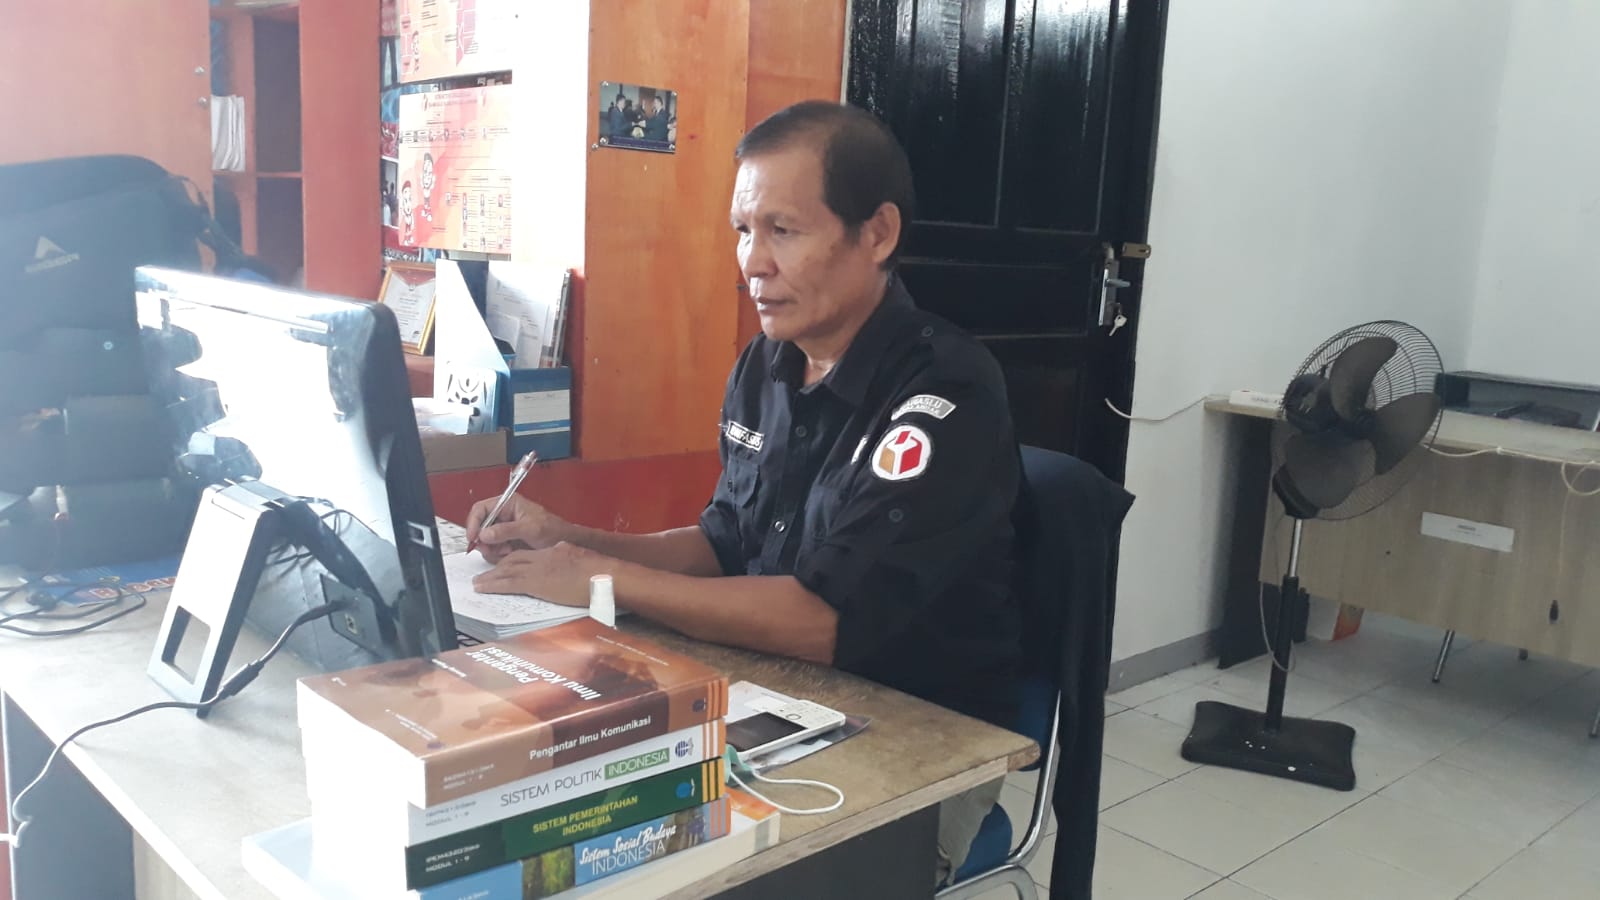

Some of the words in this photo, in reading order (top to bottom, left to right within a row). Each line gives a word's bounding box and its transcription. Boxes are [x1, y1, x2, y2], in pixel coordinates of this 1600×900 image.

[465, 652, 539, 684] Pengantar
[480, 646, 567, 685] Komunikasi
[563, 680, 601, 700] Ilmu
[529, 738, 577, 760] Pengantar
[579, 733, 599, 745] Ilmu
[600, 716, 651, 738] Komunikasi
[500, 781, 550, 807] SISTEM
[554, 768, 602, 791] POLITIK
[608, 750, 668, 776] INDONESIA
[533, 816, 566, 833] SISTEM
[569, 795, 638, 821] PEMERINTAHAN
[562, 814, 612, 836] INDONESIA
[579, 845, 610, 865] Sistem
[642, 824, 677, 846] Budaya
[592, 840, 666, 875] INDONESIA
